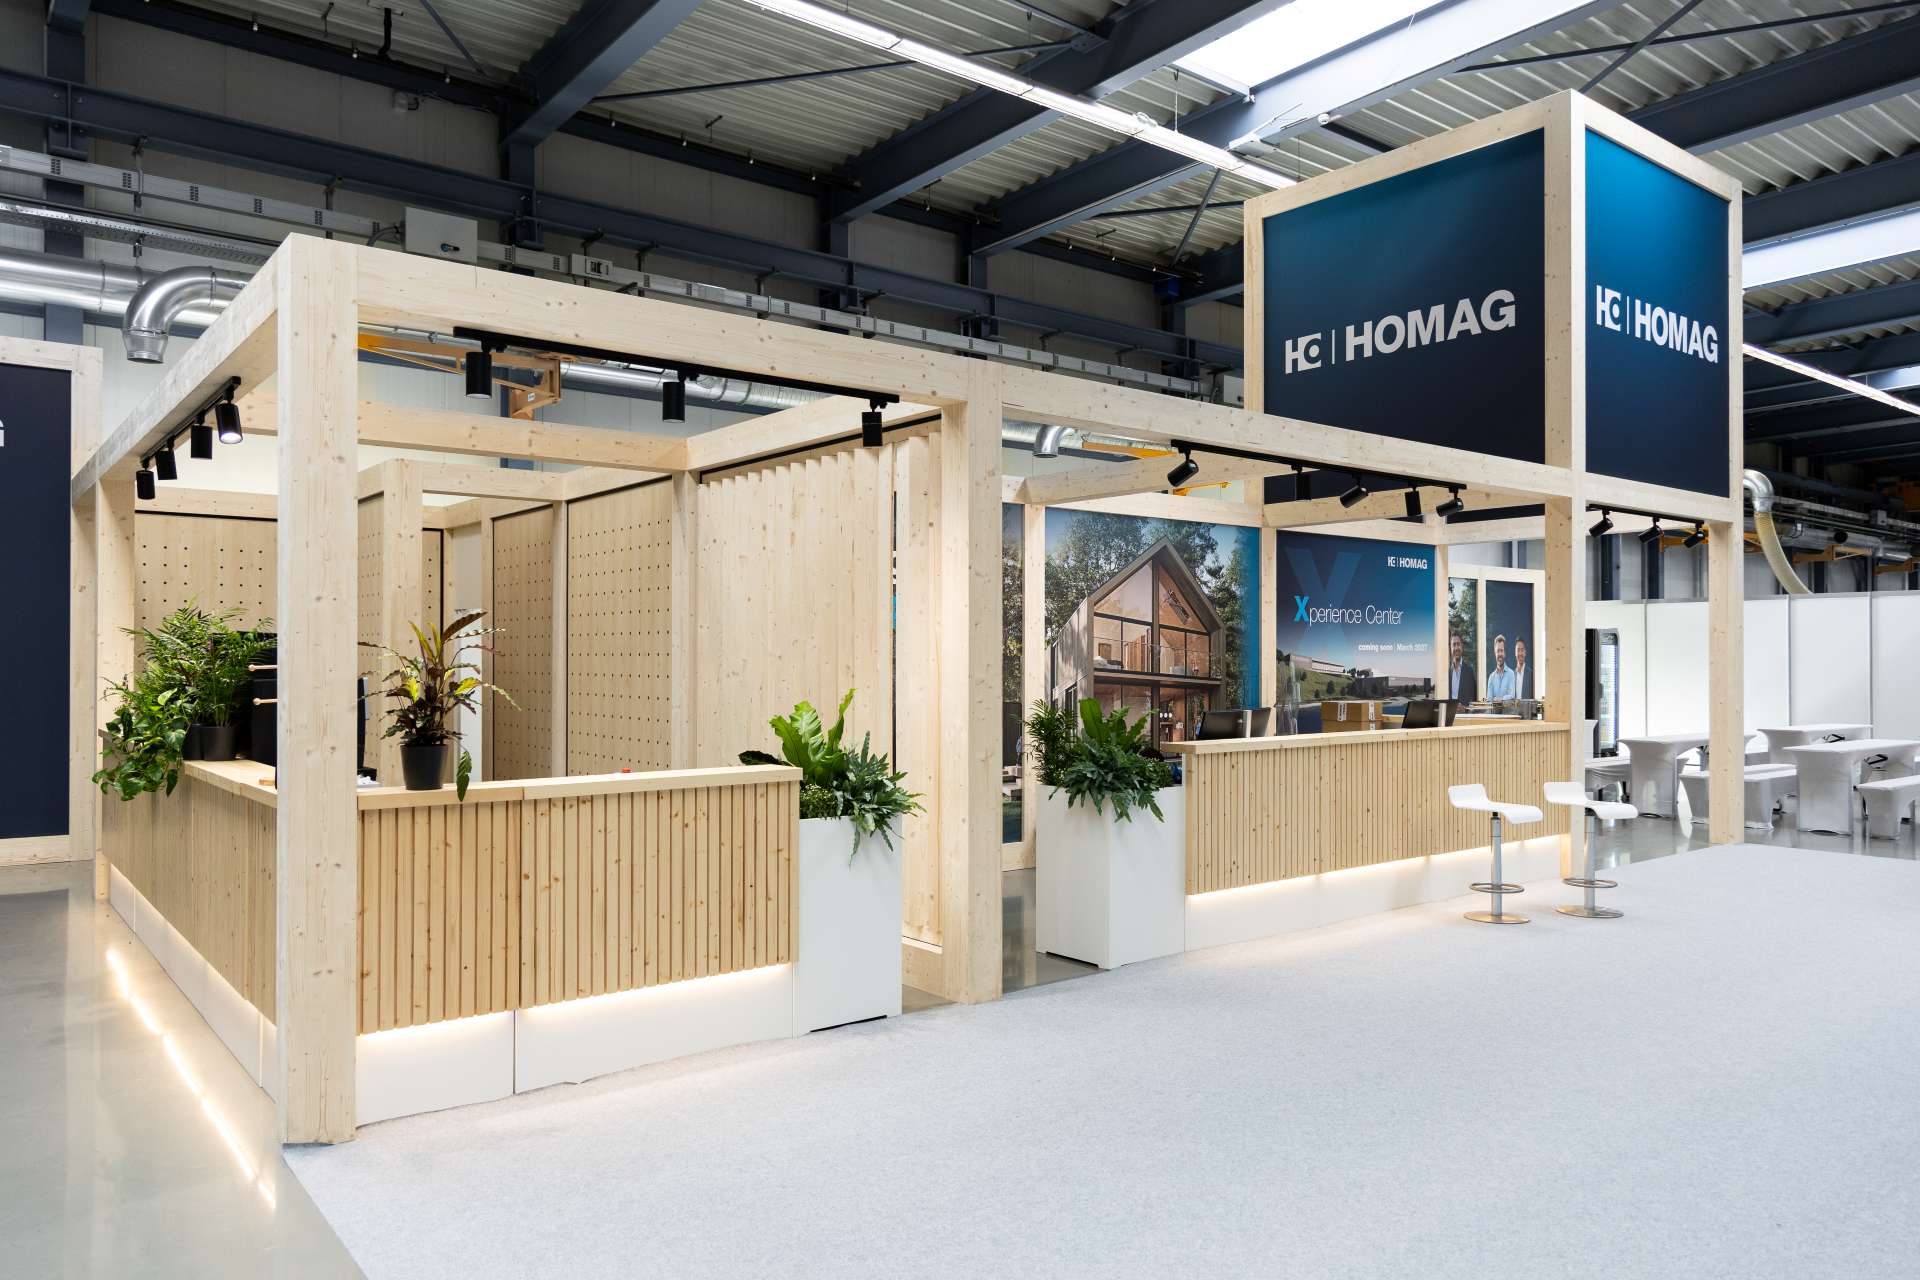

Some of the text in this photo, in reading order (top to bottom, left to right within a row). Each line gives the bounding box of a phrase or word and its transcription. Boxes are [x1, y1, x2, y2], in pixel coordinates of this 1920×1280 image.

[1345, 289, 1516, 362] HOMAG
[1634, 299, 1719, 364] HOMAG
[1399, 557, 1428, 570] HOMAG
[1294, 595, 1404, 626] Xperience Center
[1358, 643, 1380, 653] coming
